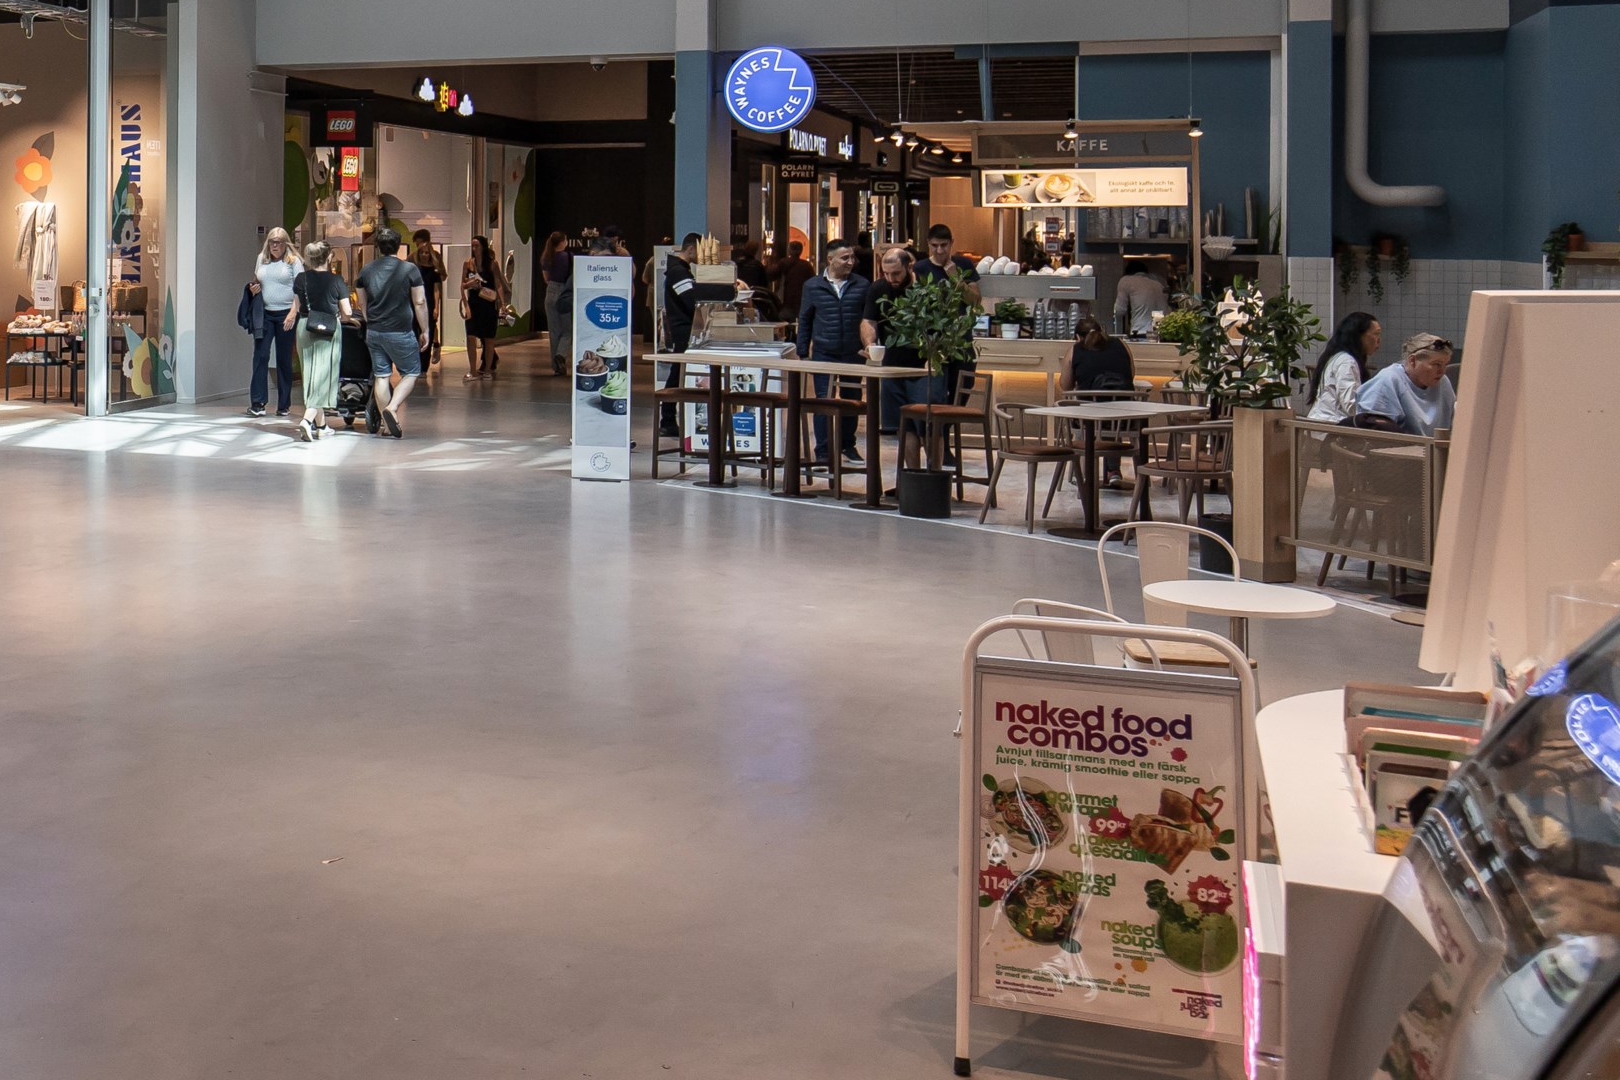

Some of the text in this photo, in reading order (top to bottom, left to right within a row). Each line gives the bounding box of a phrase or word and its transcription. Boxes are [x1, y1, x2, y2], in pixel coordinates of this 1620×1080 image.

[733, 56, 770, 110] WAYNES
[747, 95, 802, 123] COFFEE
[329, 120, 354, 131] LEGO
[1056, 139, 1109, 152] KAFFE
[343, 155, 358, 175] LEGO
[791, 170, 815, 178] PYRET
[586, 264, 619, 273] Italiensk
[593, 274, 612, 283] glass
[599, 313, 621, 323] 35 kr
[995, 699, 1193, 740] naked food
[1007, 724, 1149, 758] combos
[995, 745, 1187, 773] Avnjut tillsammans med en färsk
[995, 755, 1200, 786] juice, krämig smoothie eller soppa
[1100, 919, 1156, 937] naked
[1111, 931, 1166, 951] soups
[1187, 996, 1223, 1008] naked
